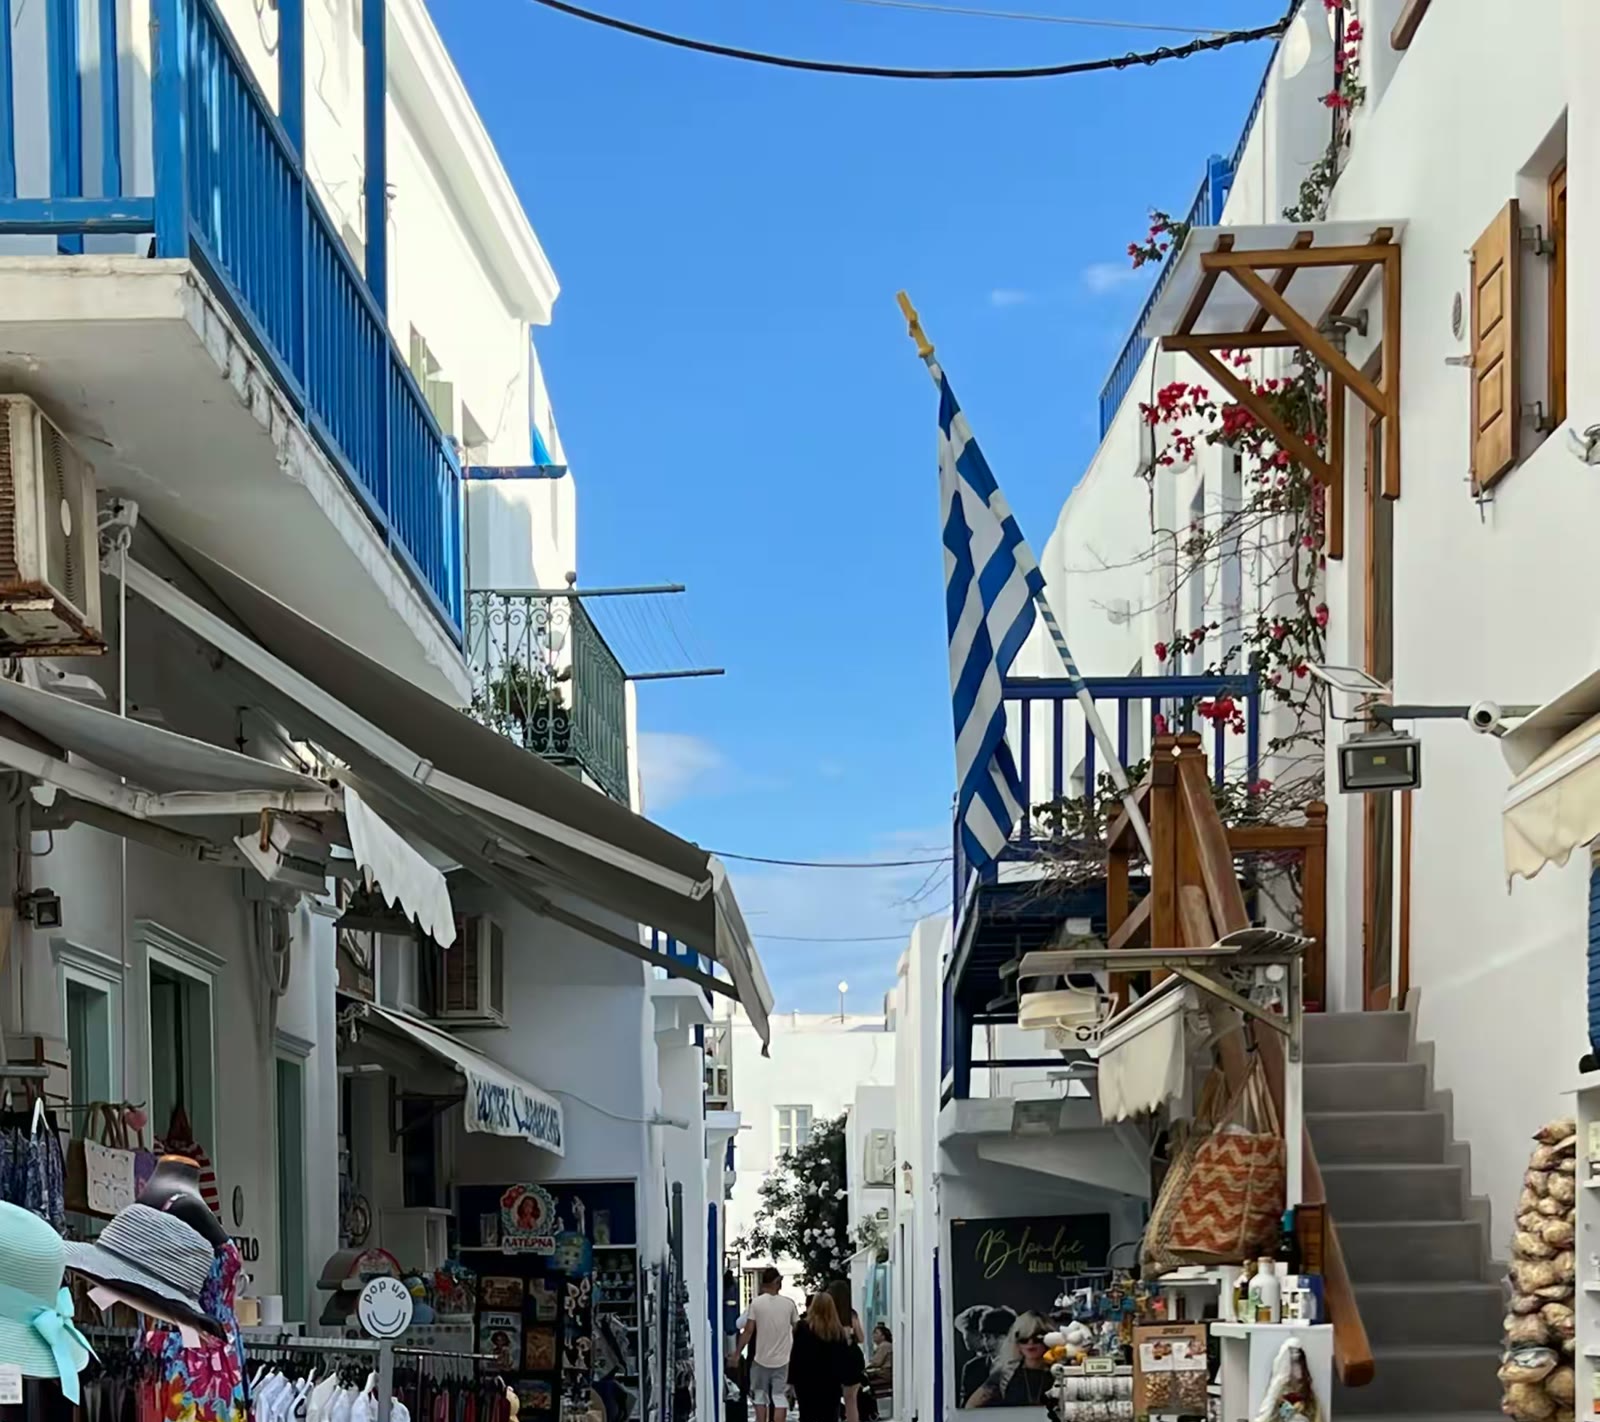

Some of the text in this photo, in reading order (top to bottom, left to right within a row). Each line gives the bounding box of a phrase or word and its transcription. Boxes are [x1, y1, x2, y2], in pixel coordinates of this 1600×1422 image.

[975, 1226, 1084, 1279] Blondie
[363, 1280, 407, 1305] pop up
